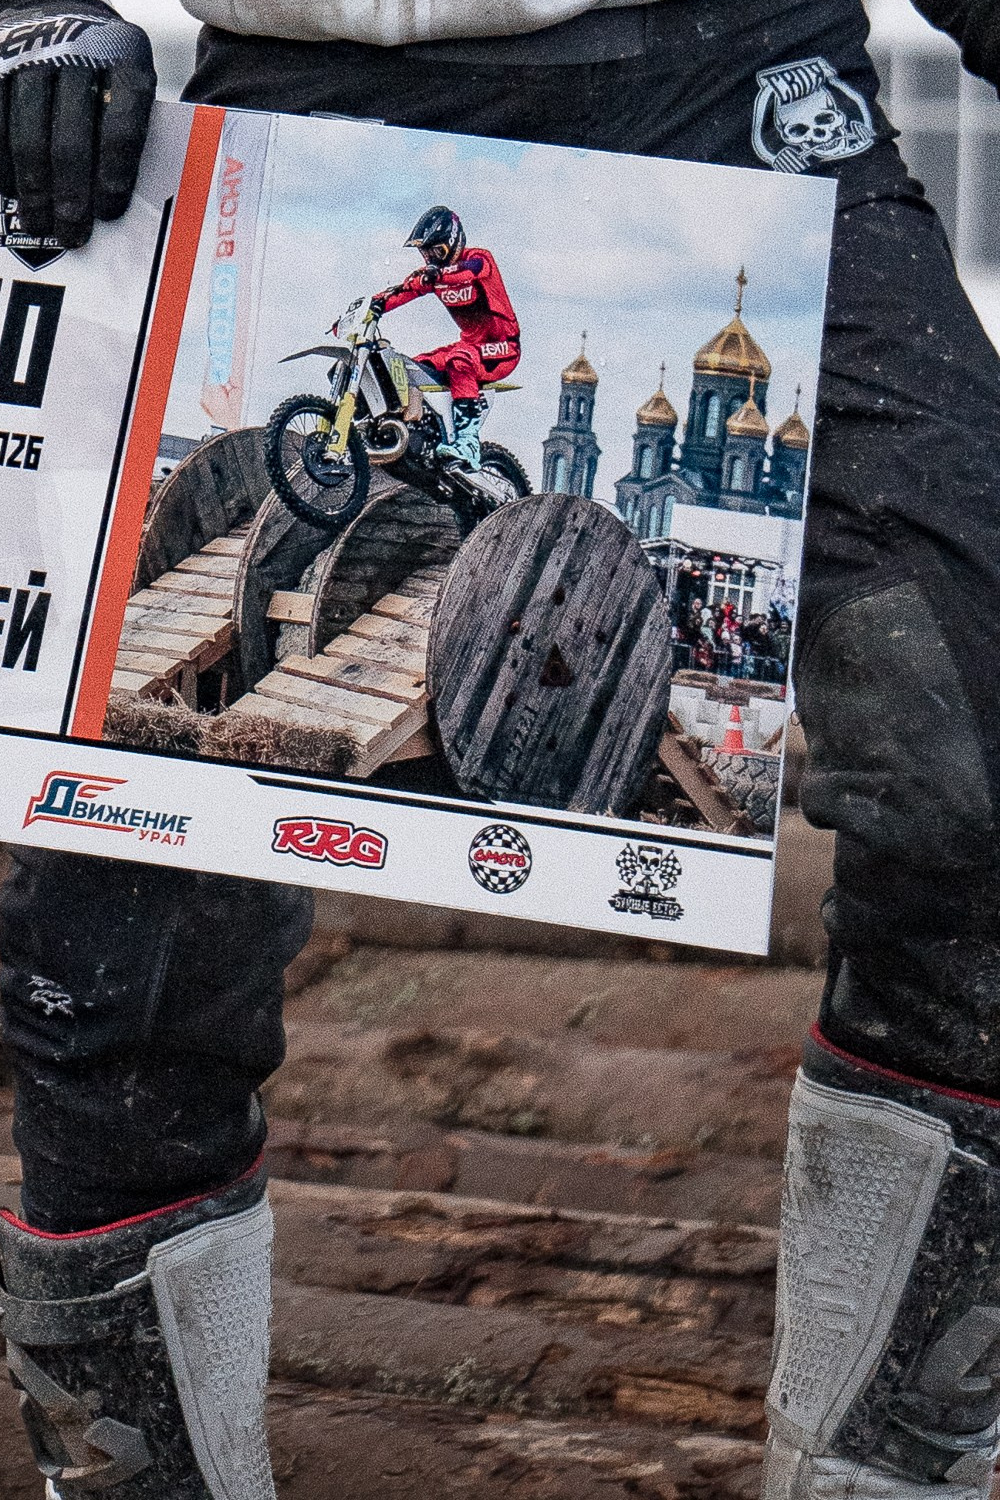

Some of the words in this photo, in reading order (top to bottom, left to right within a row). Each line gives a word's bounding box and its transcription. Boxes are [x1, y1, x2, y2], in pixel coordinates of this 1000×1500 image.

[34, 778, 193, 834] ДВИЖЕНИЕ
[138, 829, 186, 848] УРАЛ
[275, 818, 386, 867] RRG
